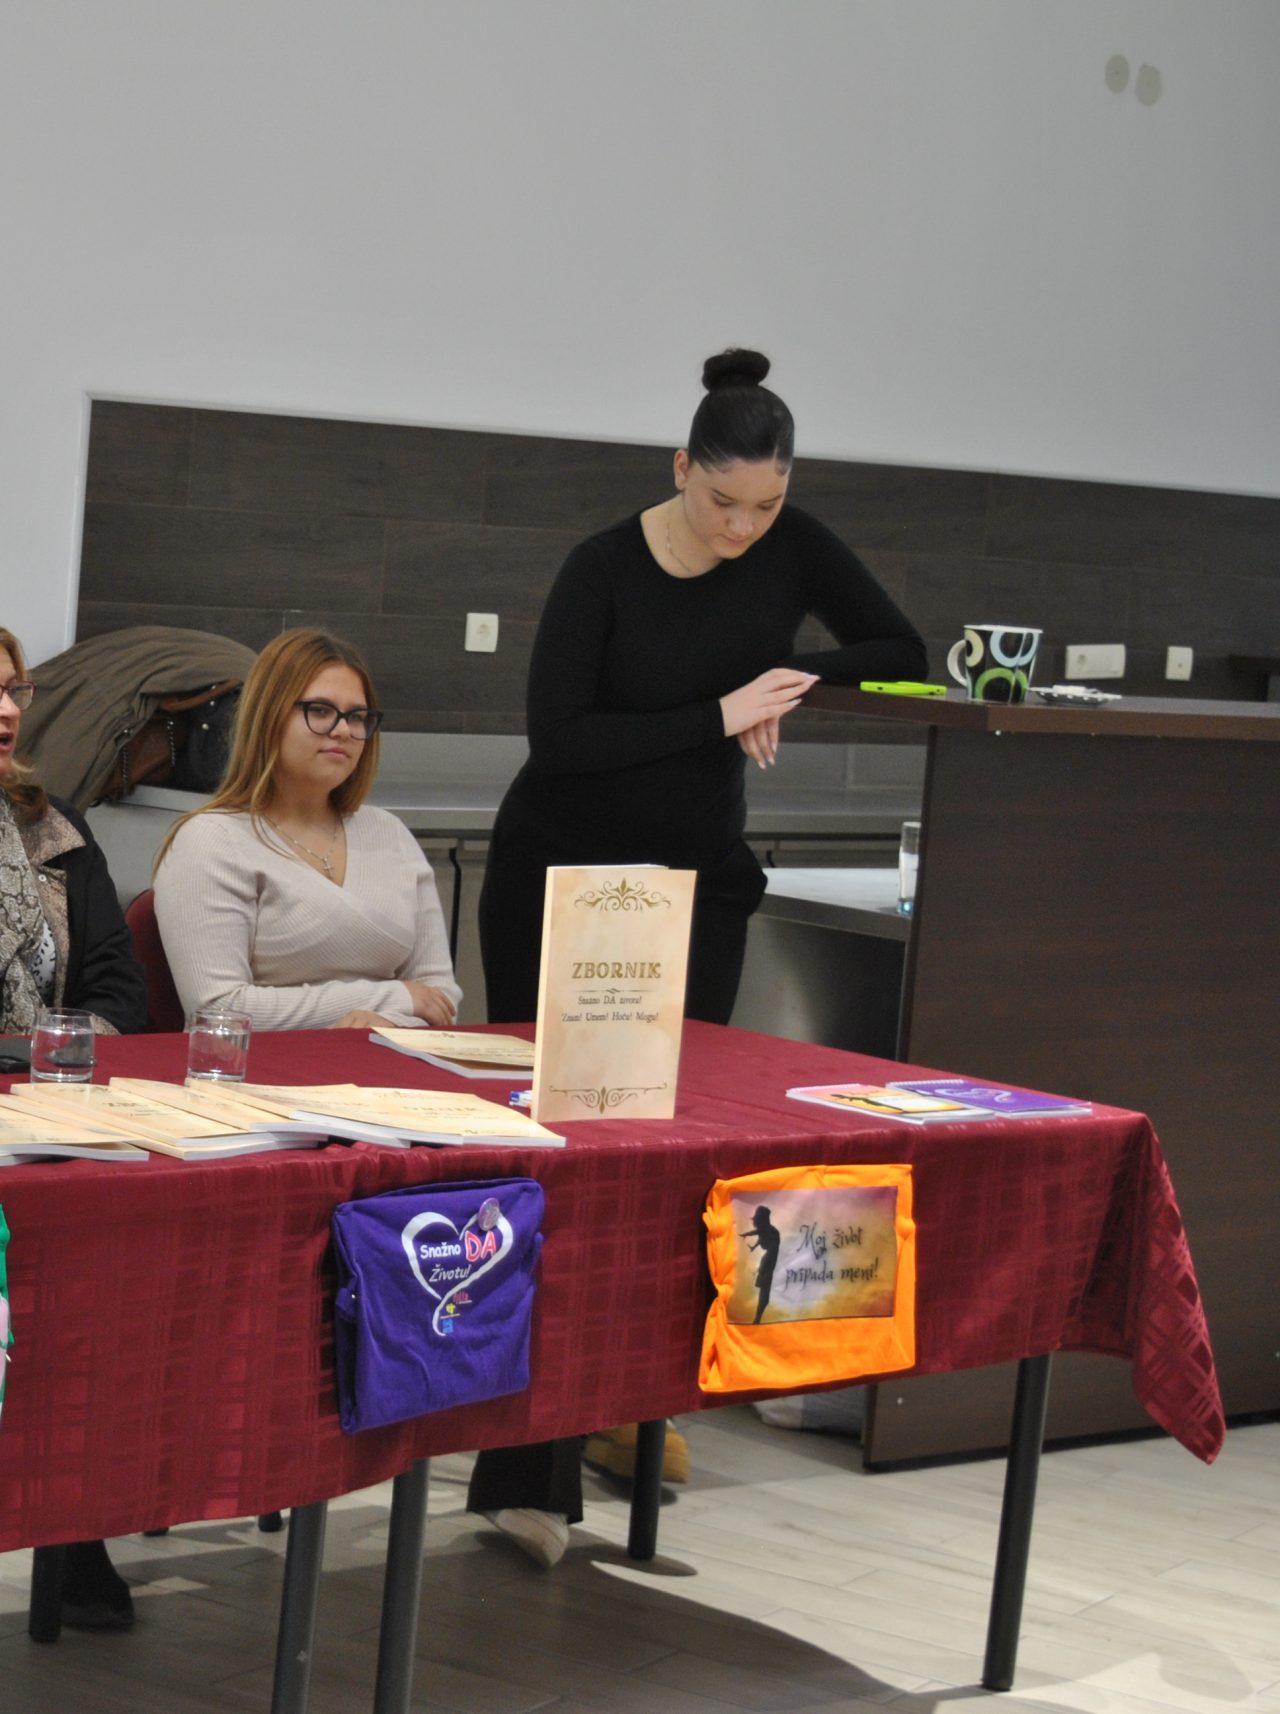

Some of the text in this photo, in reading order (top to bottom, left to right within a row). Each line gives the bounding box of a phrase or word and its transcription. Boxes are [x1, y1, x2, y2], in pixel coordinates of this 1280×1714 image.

[571, 962, 661, 979] ZBORNIK
[603, 995, 616, 1005] DA
[420, 1230, 497, 1262] Snažno DA
[796, 1222, 862, 1260] Moj život
[429, 1264, 472, 1282] Životu!
[784, 1256, 879, 1291] pripada meni!
